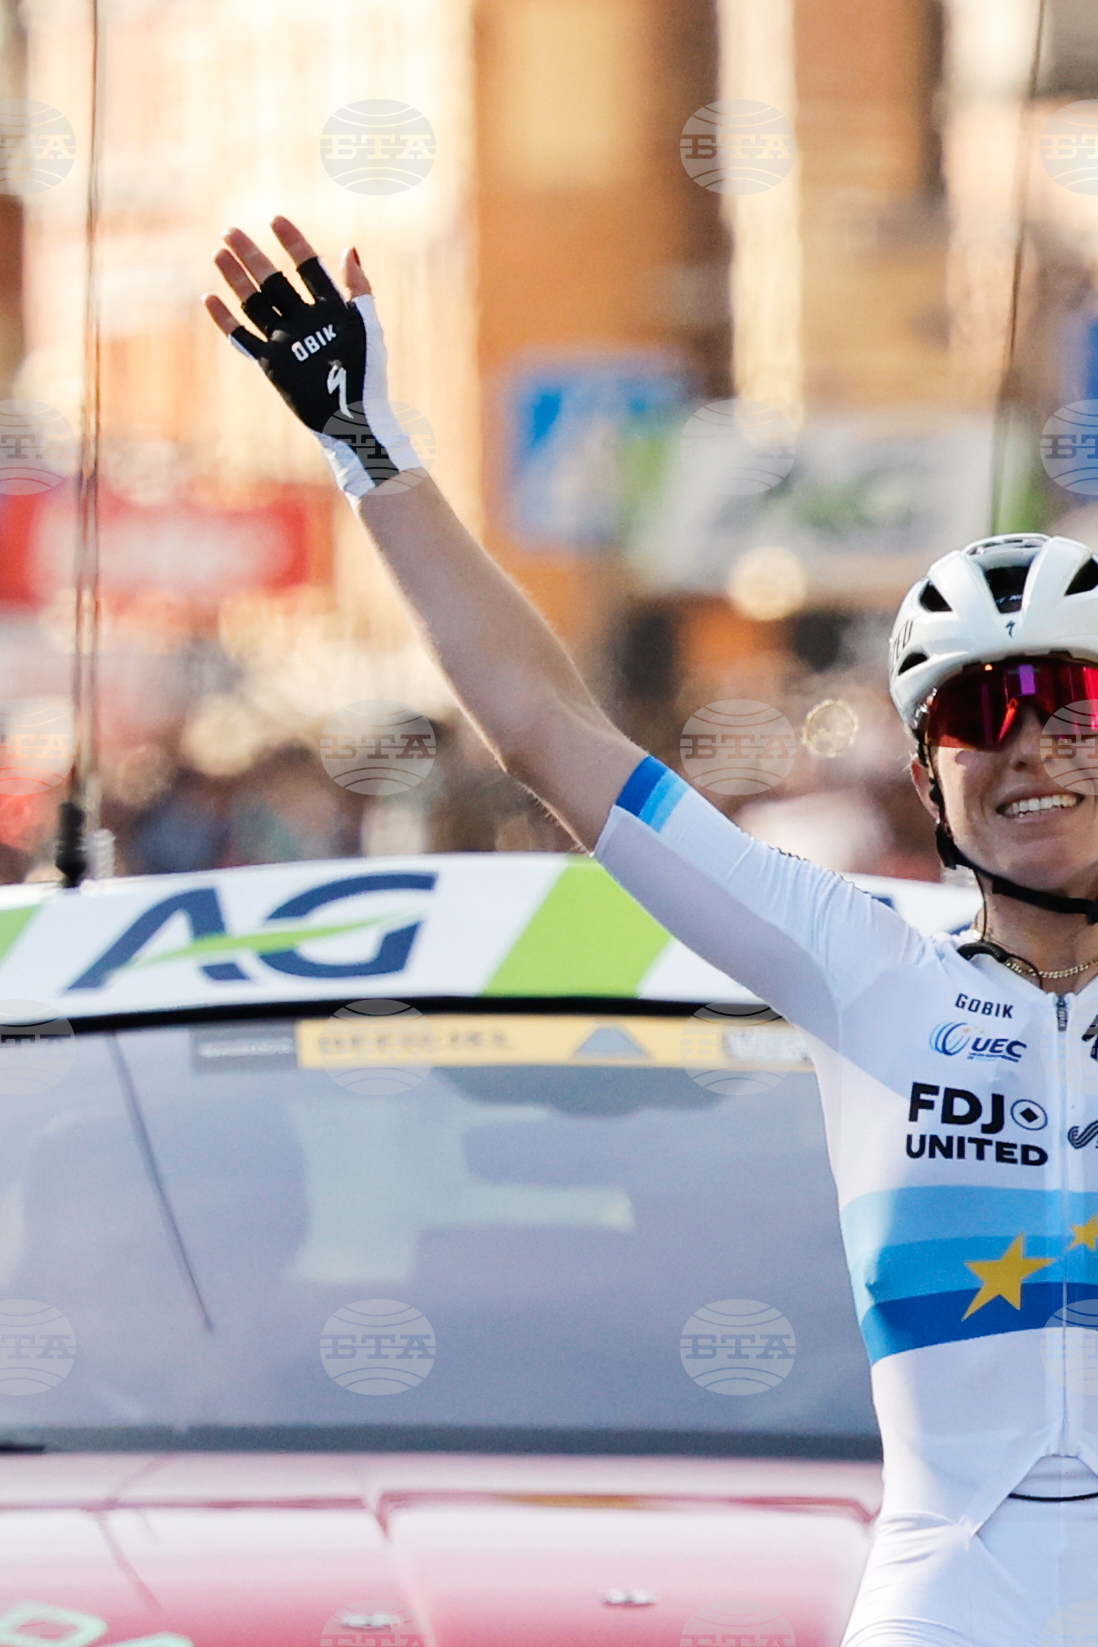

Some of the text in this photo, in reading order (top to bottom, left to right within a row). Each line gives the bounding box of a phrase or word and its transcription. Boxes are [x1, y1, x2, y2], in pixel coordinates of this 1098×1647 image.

[291, 324, 337, 362] OBIK
[62, 870, 440, 998] AG
[955, 993, 1015, 1019] GOBIK
[971, 1037, 1028, 1059] UEC
[908, 1081, 1006, 1135] FDJ
[905, 1133, 1049, 1167] UNITED
